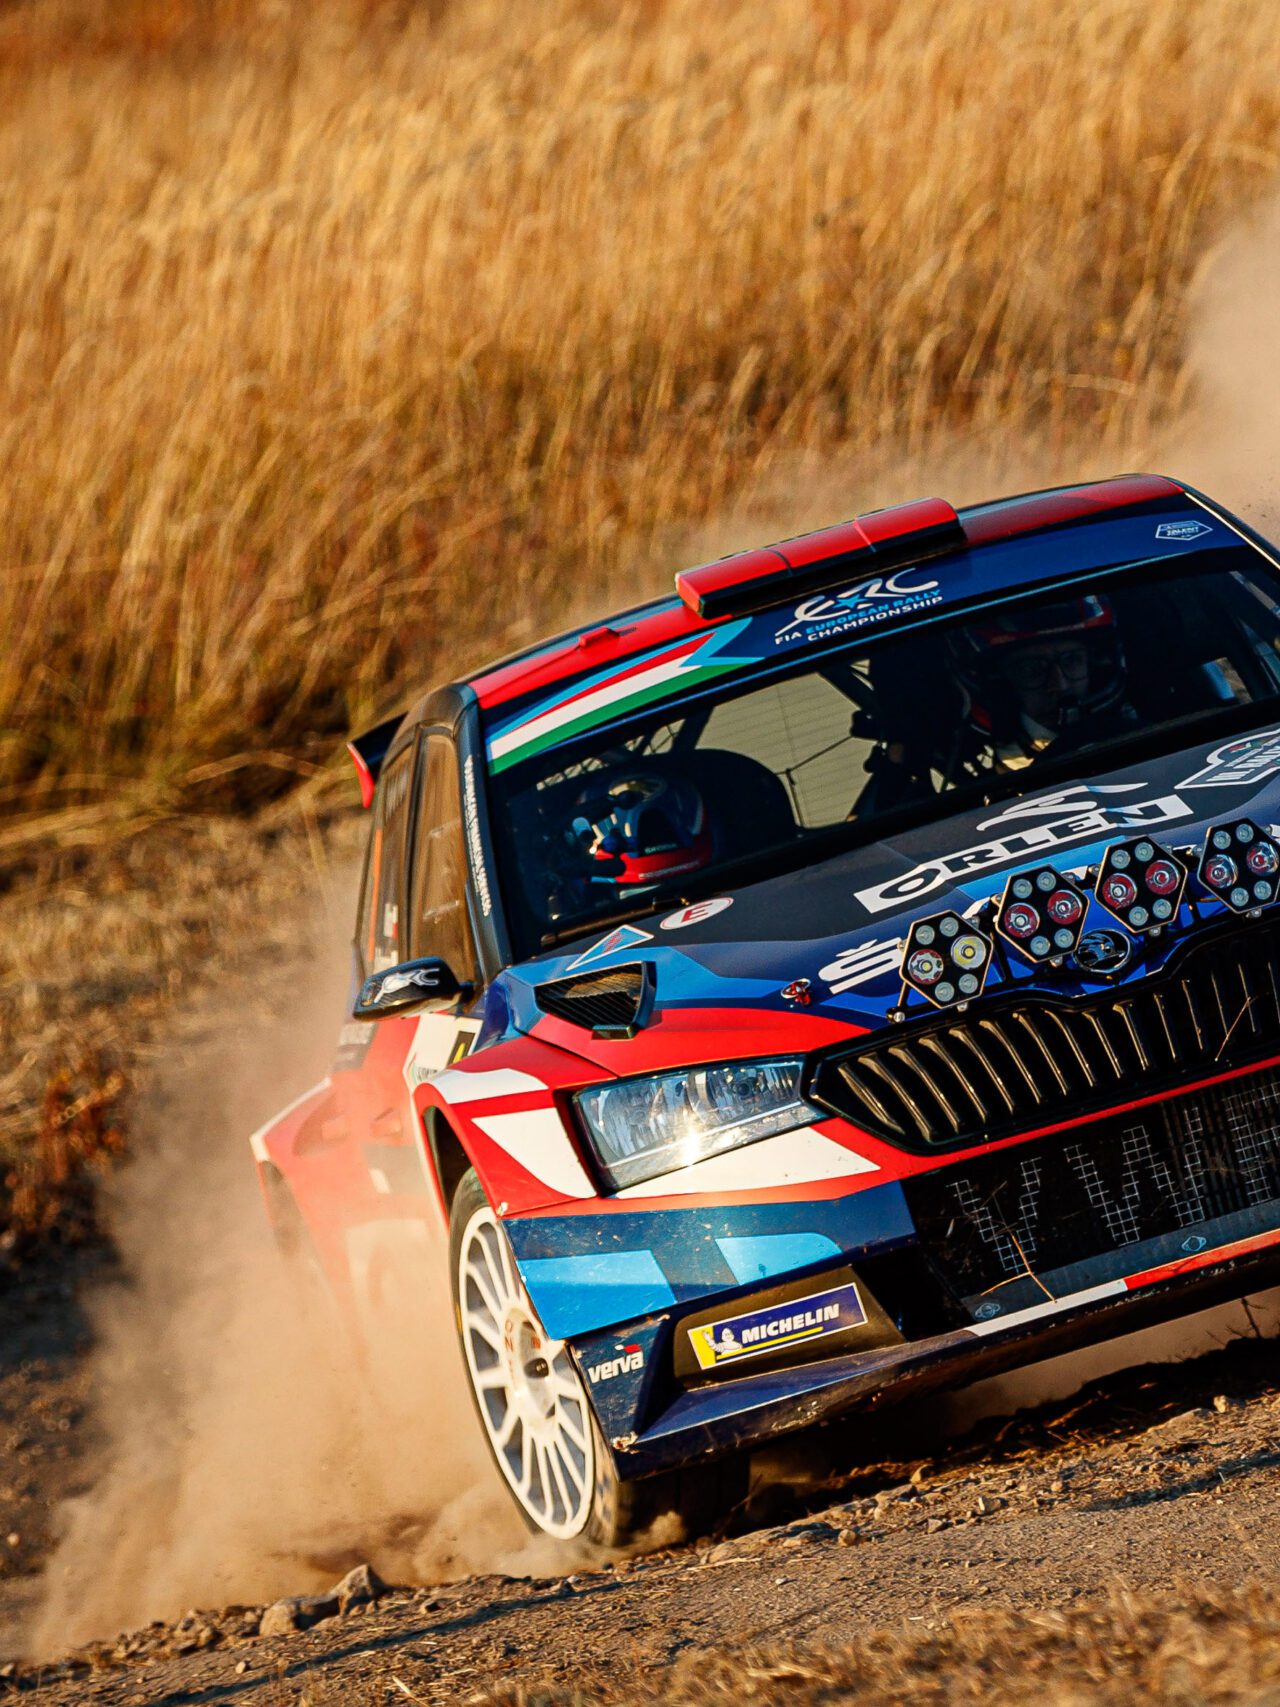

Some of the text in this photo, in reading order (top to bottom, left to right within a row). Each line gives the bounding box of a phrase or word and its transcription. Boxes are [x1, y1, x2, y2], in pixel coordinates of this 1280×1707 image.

[775, 589, 941, 645] FIA EUROPEAN RALLY
[807, 596, 943, 641] CHAMPIONSHIP
[878, 803, 1169, 900] ORLEN
[680, 902, 714, 923] E
[741, 1303, 840, 1344] MICHELIN
[588, 1350, 644, 1383] verva
